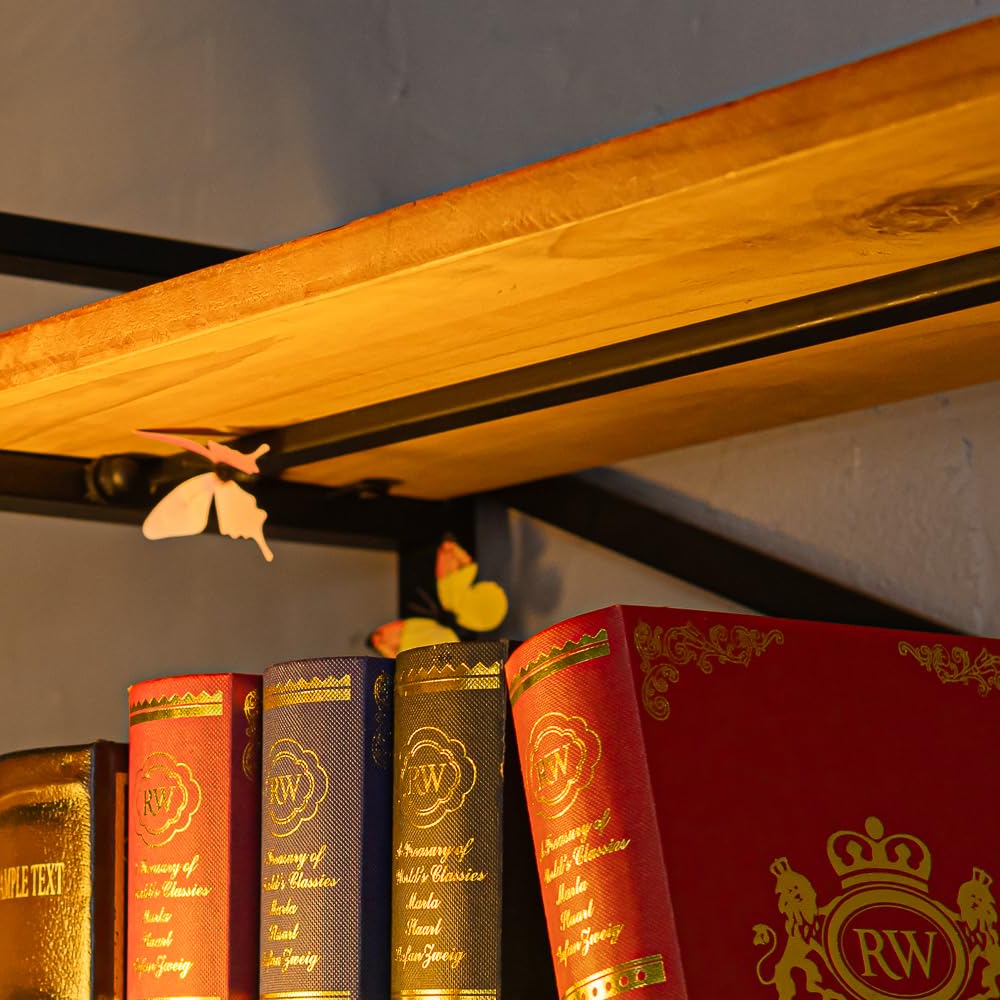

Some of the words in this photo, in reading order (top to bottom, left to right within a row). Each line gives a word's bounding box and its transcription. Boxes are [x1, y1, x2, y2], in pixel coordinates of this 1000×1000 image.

[144, 786, 177, 817] RW
[31, 862, 65, 897] TEXT
[430, 863, 488, 882] Classics
[853, 928, 937, 981] RW
